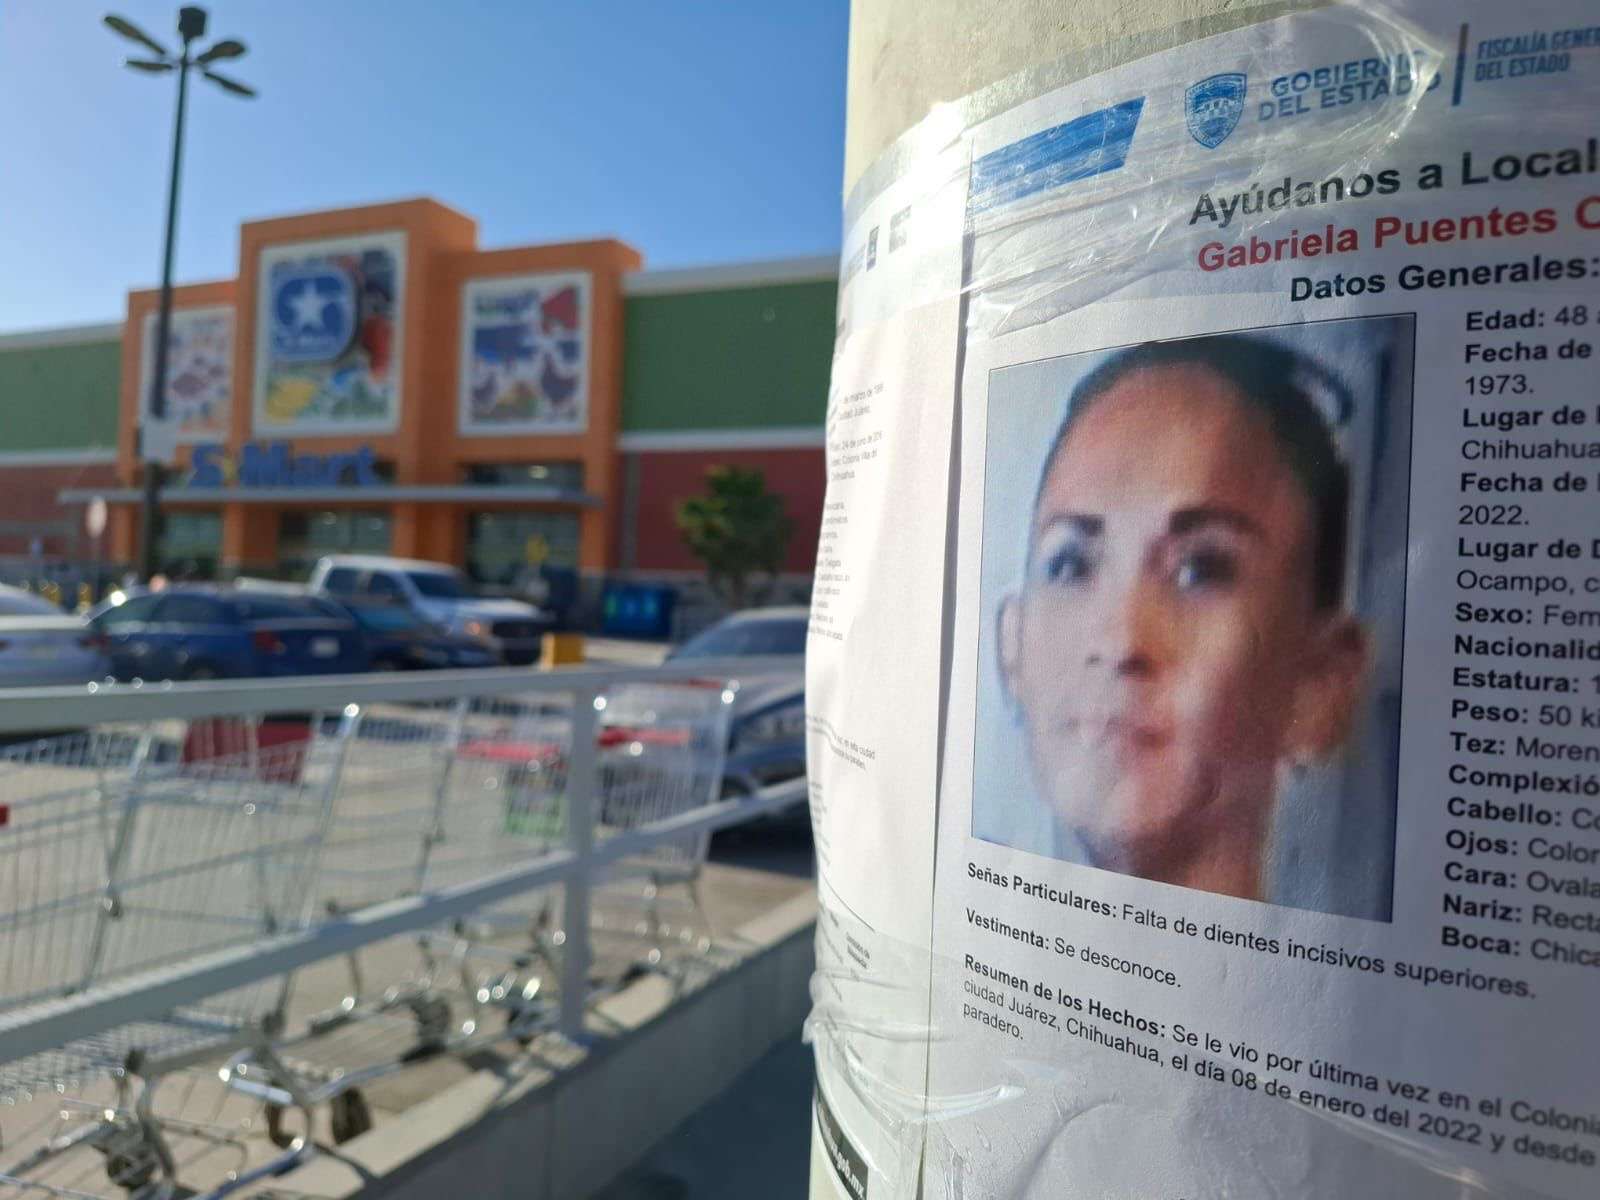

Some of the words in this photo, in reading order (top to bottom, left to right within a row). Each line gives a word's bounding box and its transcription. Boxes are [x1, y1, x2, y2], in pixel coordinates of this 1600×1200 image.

[1474, 60, 1504, 82] DEL
[1508, 53, 1570, 78] ESTADO
[1258, 95, 1310, 121] DEL
[1189, 169, 1400, 229] Ayúdanos
[1418, 163, 1442, 191] a
[1198, 224, 1359, 272] Gabriela
[1375, 206, 1557, 249] Puentes
[1290, 273, 1386, 302] Datos
[1399, 255, 1600, 290] Generales:
[1465, 308, 1545, 332] Edad:
[1553, 305, 1588, 326] 48
[1464, 341, 1548, 364] Fecha
[1557, 339, 1592, 360] de
[1464, 374, 1534, 396] 1973.
[1462, 408, 1543, 432] Lugar
[1552, 405, 1586, 426] de
[1460, 472, 1544, 493] Fecha
[1553, 472, 1587, 493] de
[1458, 504, 1530, 526] 2022.
[1457, 537, 1538, 562] Lugar
[1547, 538, 1582, 559] de
[1456, 569, 1575, 597] Ocampo,
[1454, 602, 1533, 625] Sexo:
[1452, 667, 1579, 694] Estatura:
[1451, 699, 1529, 724] Peso:
[1538, 704, 1572, 727] 50
[1450, 731, 1505, 755] Tez:
[1447, 797, 1561, 827] Cabello:
[1445, 829, 1517, 856] Ojos:
[1528, 838, 1600, 866] Color
[1444, 862, 1516, 888] Cara:
[1442, 894, 1522, 923] Nariz:
[967, 862, 1008, 888] Señas
[1013, 876, 1117, 918] Particulares:
[1122, 903, 1167, 930] Falta
[1173, 913, 1198, 936] de
[1204, 923, 1280, 954] dientes
[1287, 938, 1385, 973] incisivos
[1394, 960, 1537, 999] superiores.
[1441, 926, 1520, 956] Boca:
[966, 907, 1050, 950] Vestimenta:
[1054, 937, 1075, 957] Se
[1080, 948, 1182, 987] desconoce.
[963, 1003, 1024, 1040] paradero.
[964, 953, 1028, 992] Resumen
[1034, 982, 1053, 1000] de
[1058, 988, 1083, 1011] los
[1088, 998, 1166, 1037] Hechos:
[1172, 1024, 1198, 1046] Se
[1205, 1033, 1222, 1053] le
[1229, 1042, 1258, 1063] vio
[1266, 1052, 1302, 1073] por
[1309, 1058, 1378, 1091] última
[1387, 1079, 1430, 1102] vez
[1438, 1090, 1470, 1110] en
[1478, 1097, 1501, 1117] el
[1510, 1100, 1600, 1136] Coloni
[964, 979, 1004, 1007] ciudad
[1008, 995, 1061, 1031] Juárez,
[1066, 1018, 1164, 1067] Chihuahua,
[1171, 1054, 1188, 1071] el
[1194, 1061, 1225, 1082] día
[1231, 1068, 1257, 1090] 08
[1264, 1078, 1291, 1099] de
[1299, 1089, 1366, 1118] enero
[1373, 1104, 1409, 1128] del
[1418, 1113, 1482, 1144] 2022
[1489, 1130, 1506, 1153] y
[1513, 1134, 1596, 1167] desde
